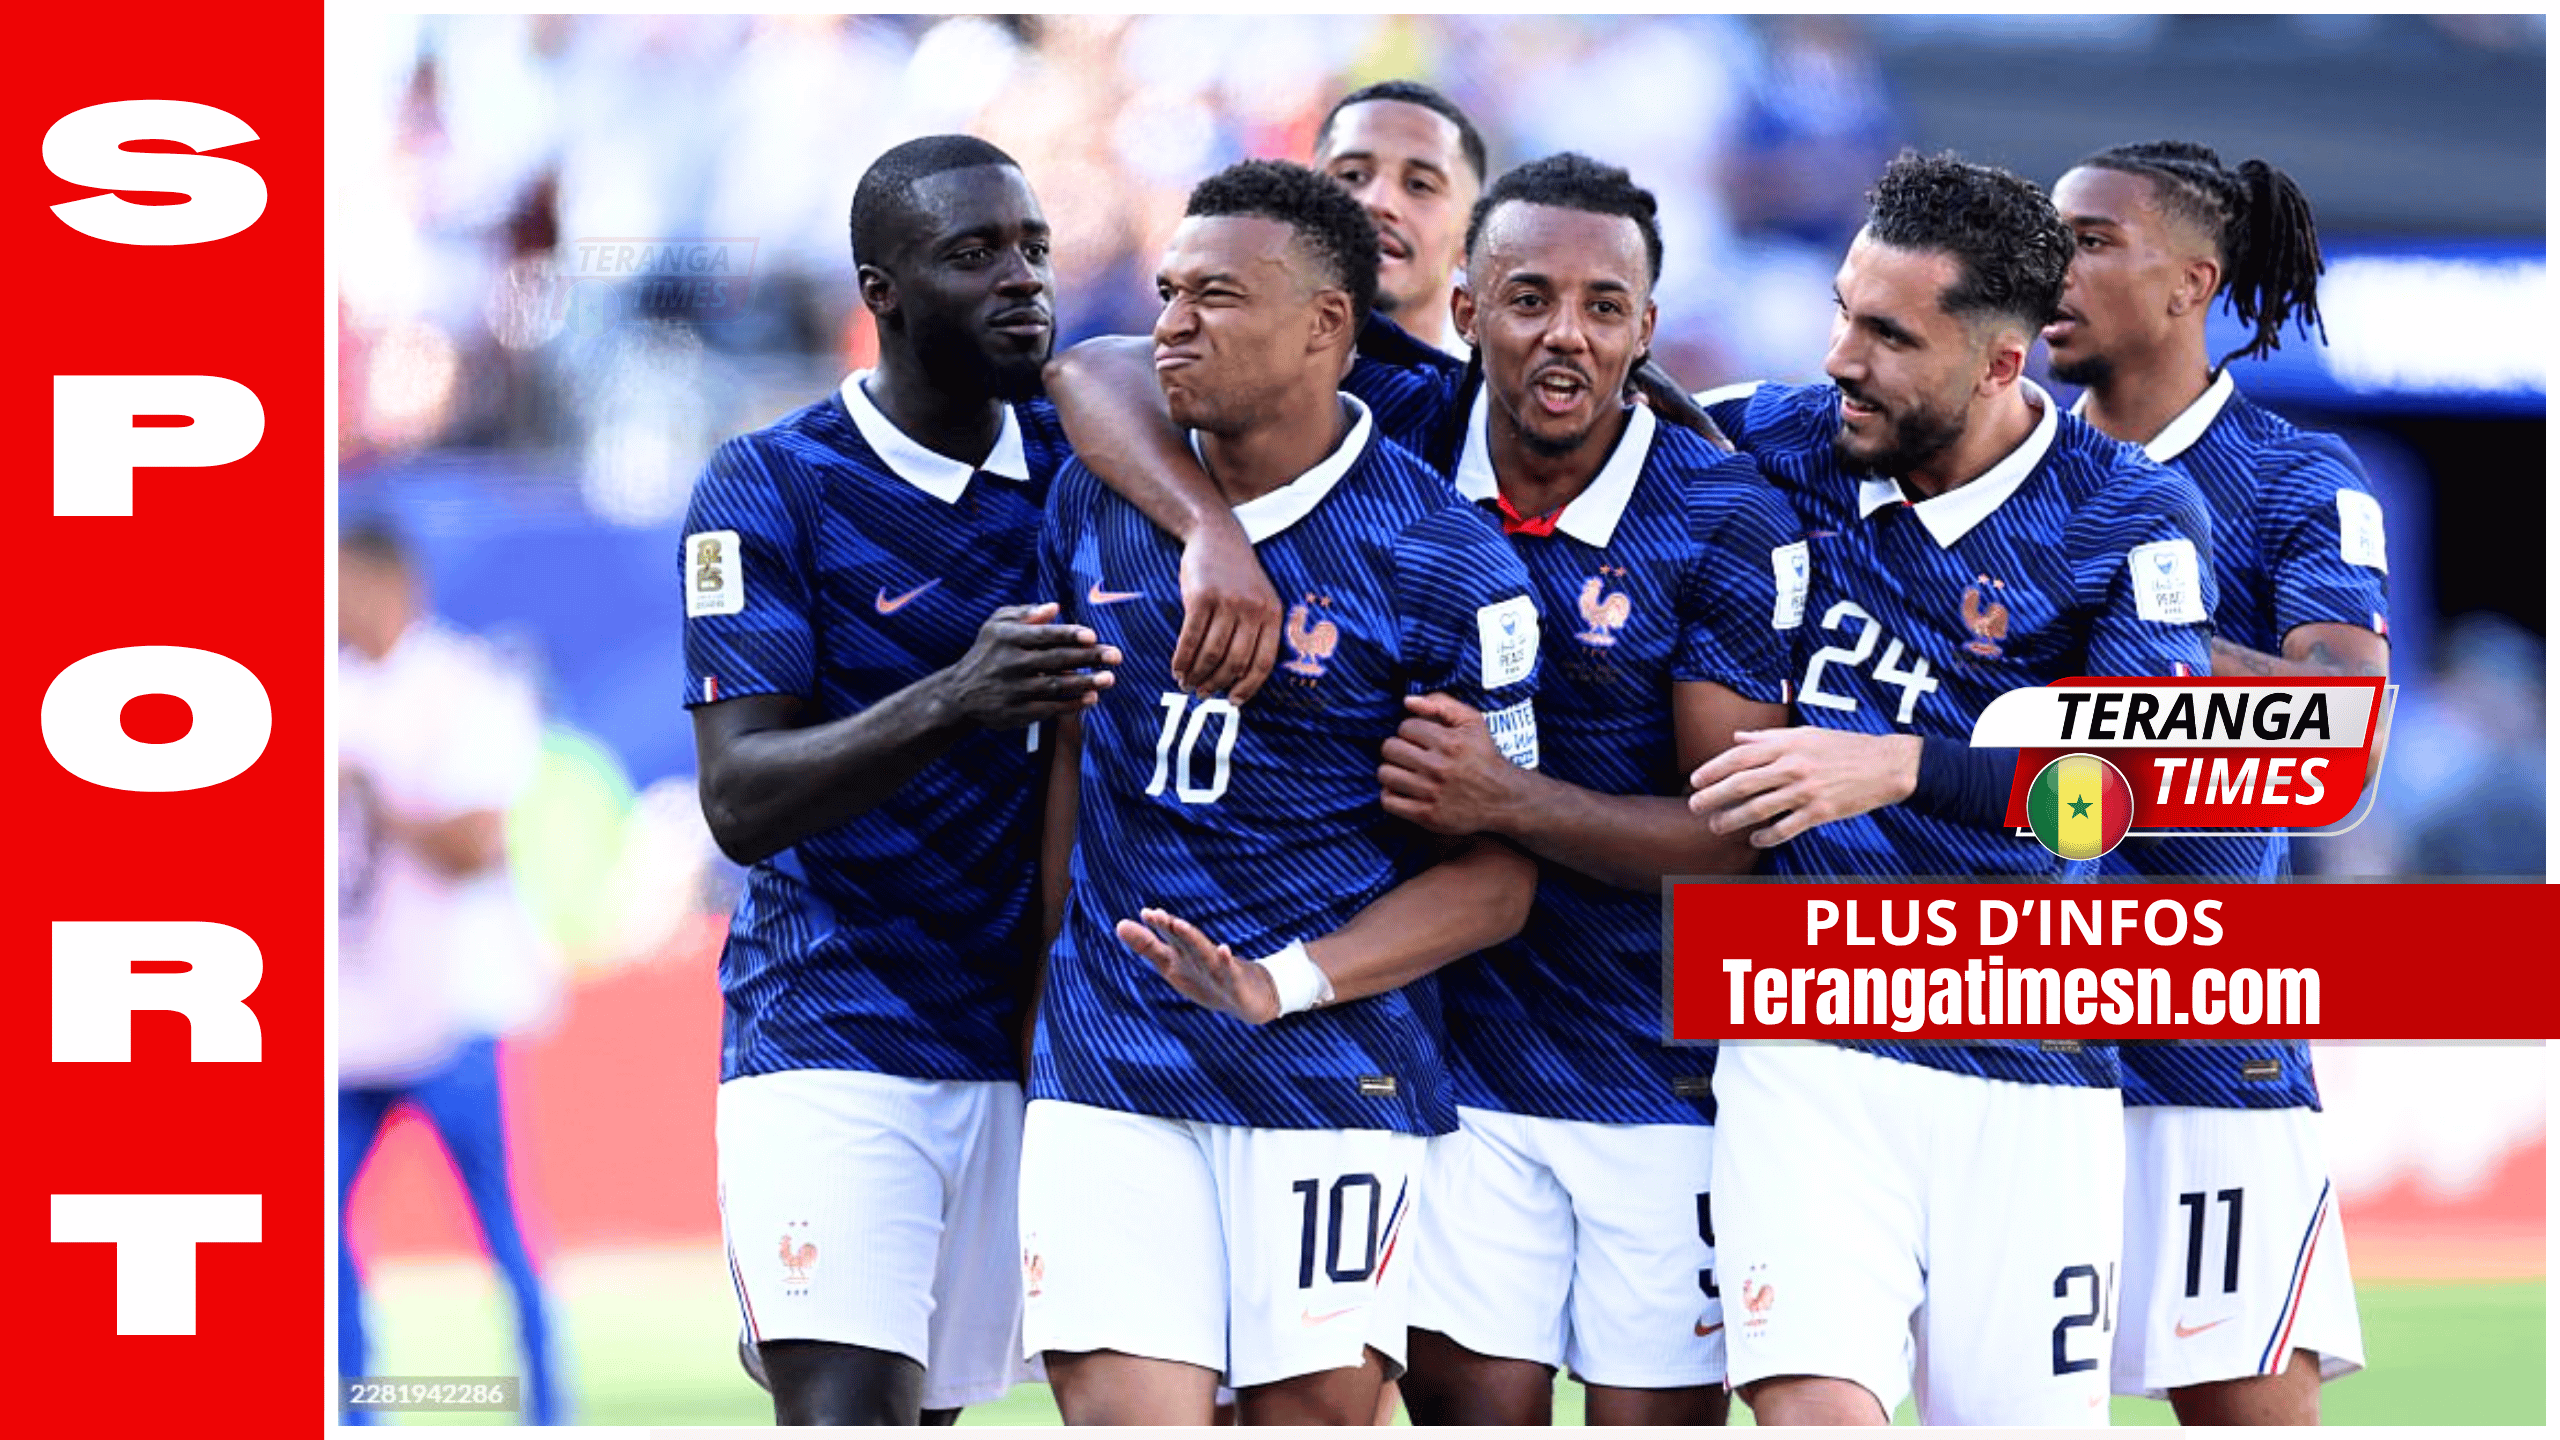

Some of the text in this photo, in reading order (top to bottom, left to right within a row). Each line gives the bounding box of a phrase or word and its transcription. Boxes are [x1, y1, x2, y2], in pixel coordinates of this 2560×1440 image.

[1798, 600, 1938, 724] 24
[1145, 693, 1240, 804] 10
[1292, 1173, 1381, 1289] 10
[2179, 1187, 2245, 1297] 11
[2052, 1261, 2115, 1376] 2
